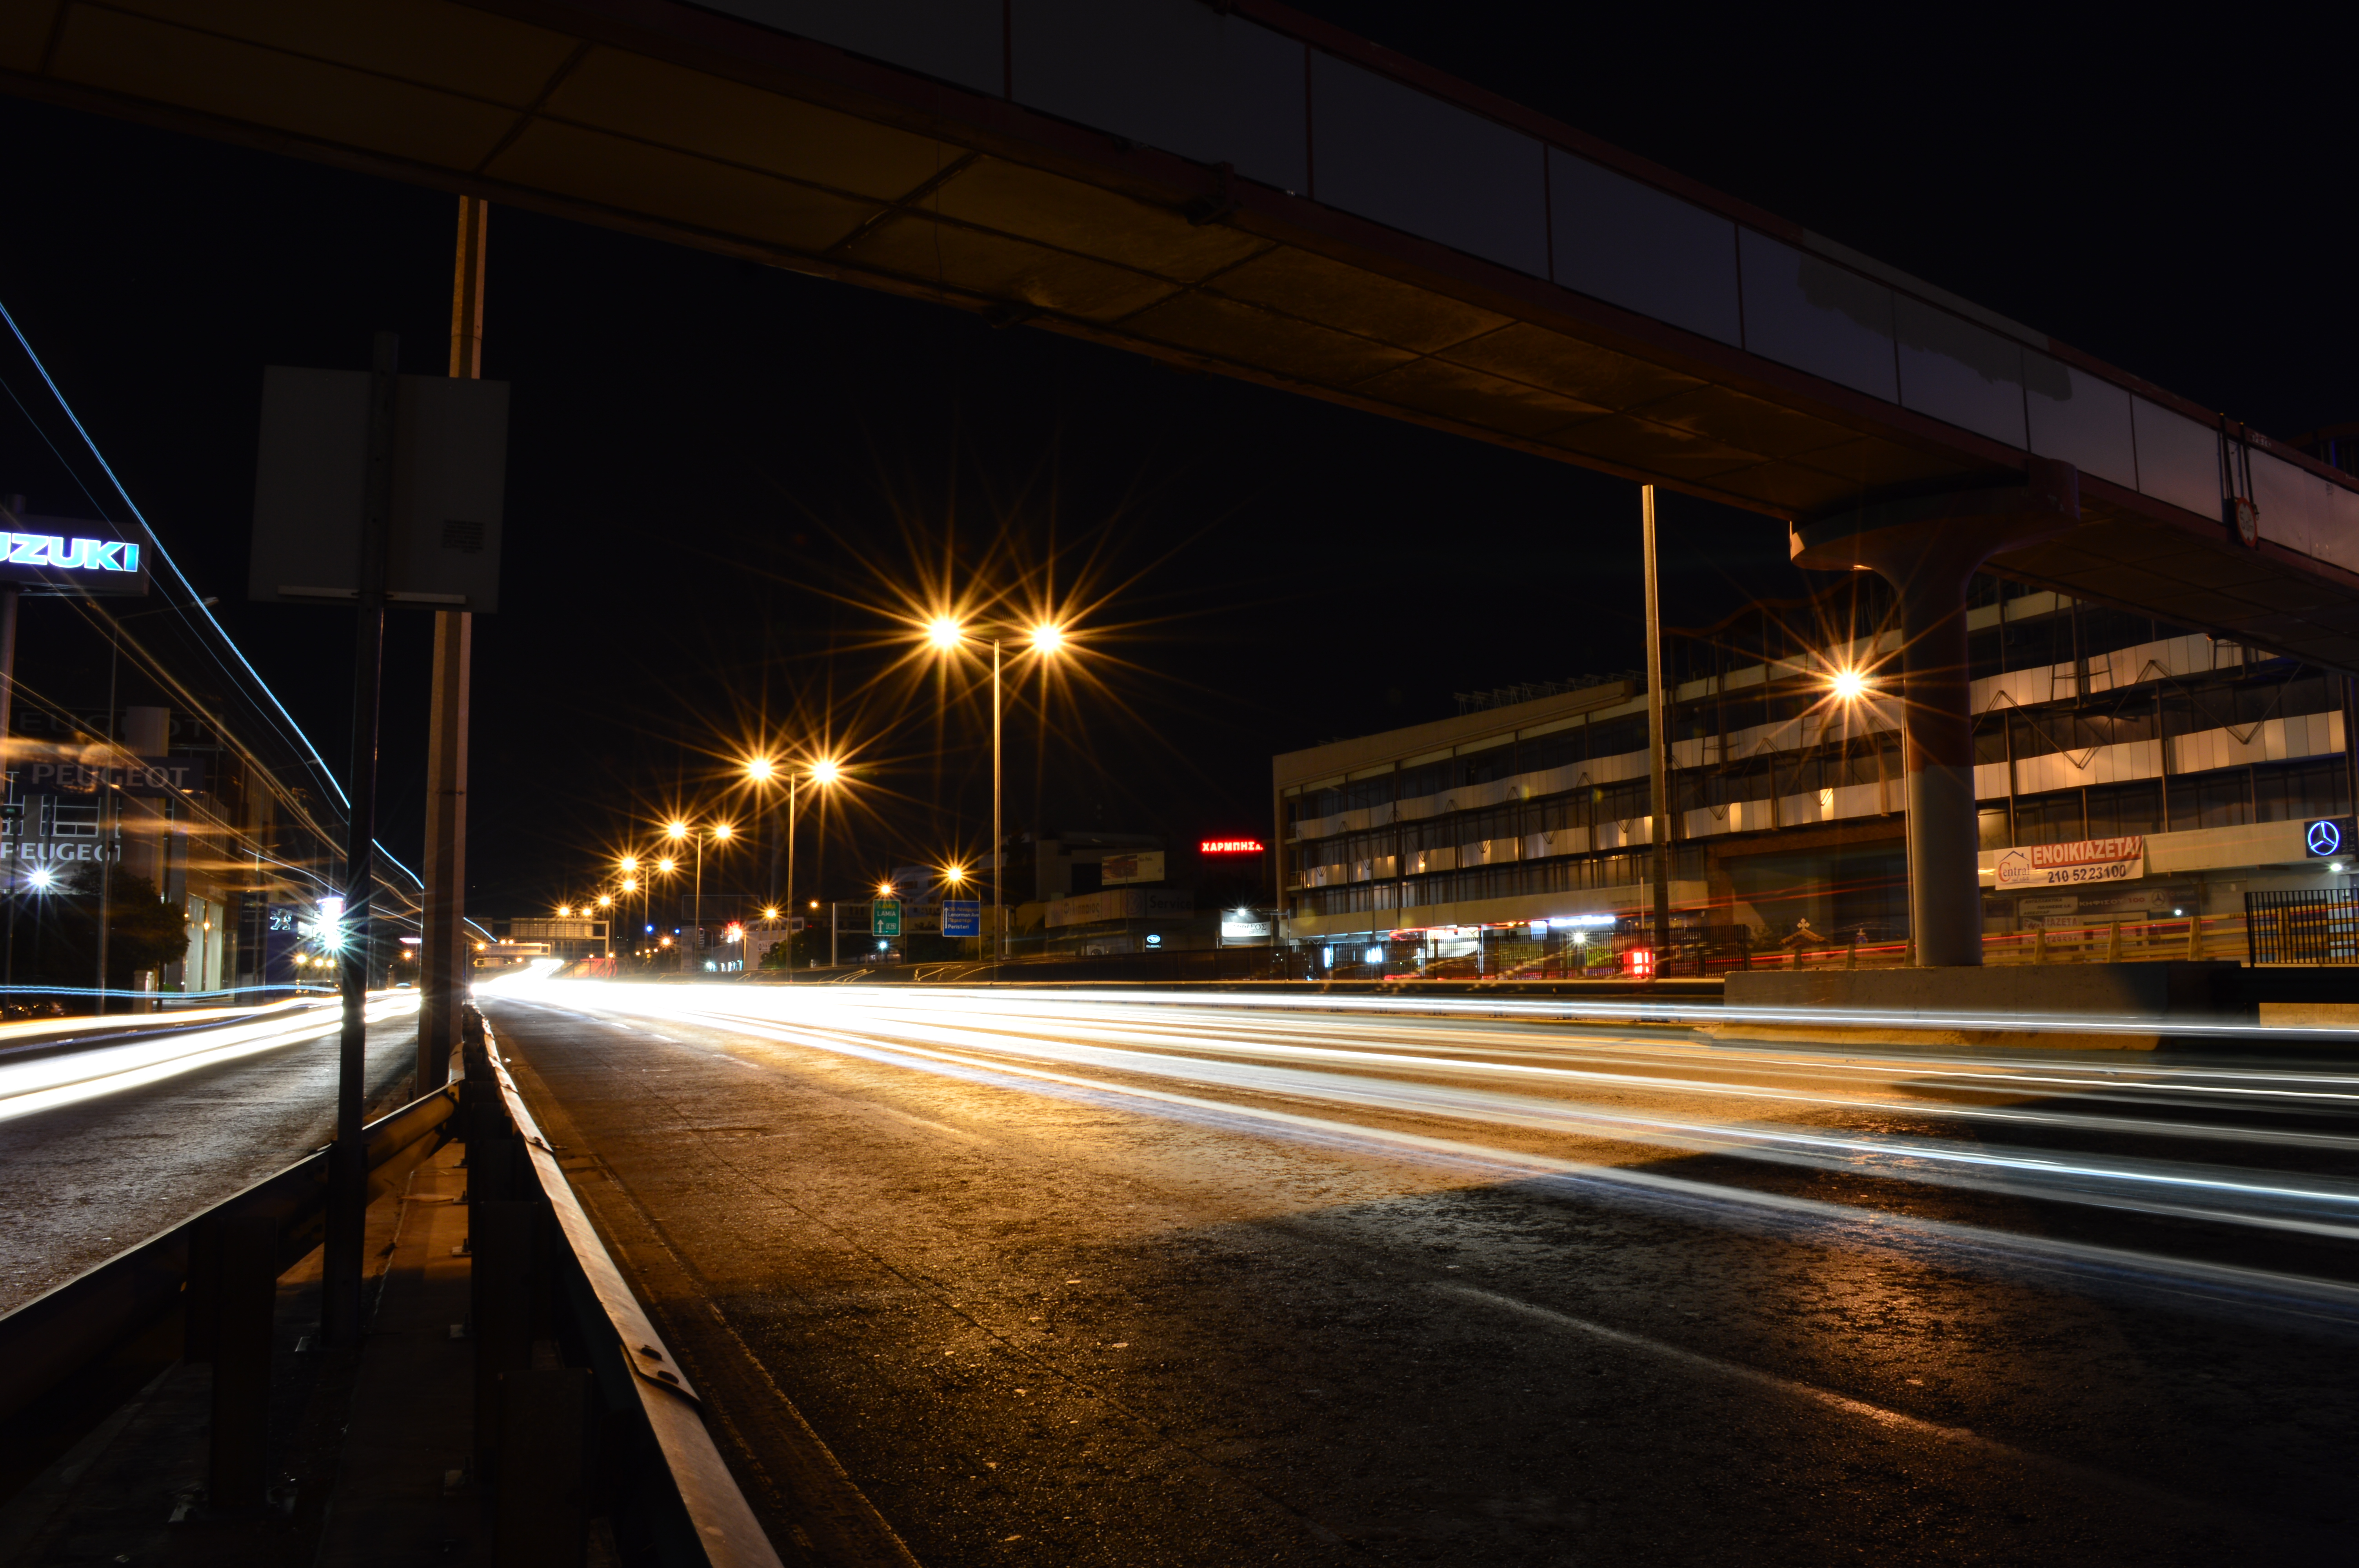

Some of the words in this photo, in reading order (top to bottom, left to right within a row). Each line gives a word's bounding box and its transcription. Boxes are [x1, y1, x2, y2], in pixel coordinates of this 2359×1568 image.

[32, 764, 189, 788] PEUGEOT
[1202, 841, 1255, 852] ΧΑΡΜΠΗΣ
[2033, 835, 2140, 865] ΕΝΟΙΚΙΑΖΕΤΑΙ
[1998, 862, 2030, 882] Central
[2047, 870, 2069, 883] 210
[1149, 895, 1192, 909] Service
[2079, 898, 2125, 907] ΚΗΦΙΣΟΥ
